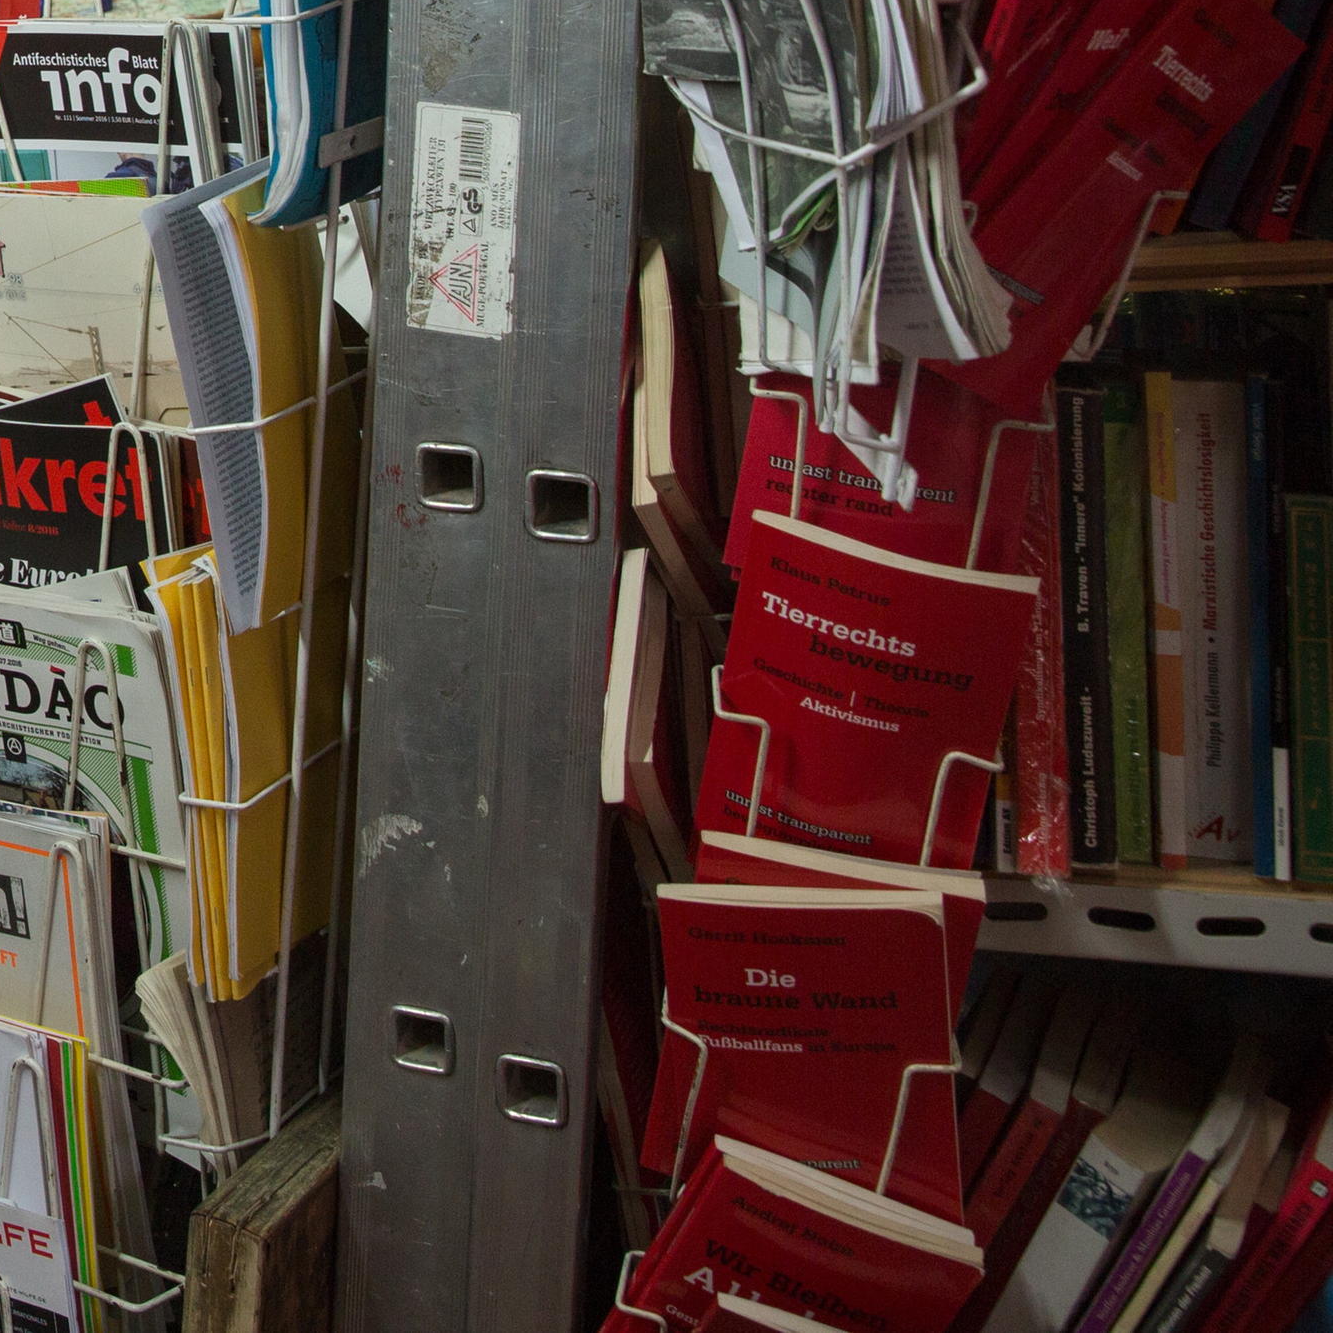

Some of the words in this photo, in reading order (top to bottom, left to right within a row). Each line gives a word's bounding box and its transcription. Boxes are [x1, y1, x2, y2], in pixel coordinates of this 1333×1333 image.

[13, 52, 107, 69] Antifaschistisches
[132, 55, 159, 70] Blatt
[1069, 395, 1086, 492] Kolonisierung
[1196, 411, 1218, 541] Geschichtslosigkeit
[1076, 565, 1090, 614] Traven
[1201, 544, 1218, 631] Marxistische
[761, 589, 917, 658] Tierrechts
[808, 633, 975, 692] bewegung
[1203, 651, 1222, 718] Kellermann
[800, 695, 900, 733] Aktivismus
[1205, 721, 1224, 768] Philippe
[777, 809, 872, 846] transparent
[1082, 779, 1099, 848] Christoph
[693, 985, 801, 1010] braune
[811, 991, 899, 1010] Wand
[745, 968, 797, 988] Die
[699, 1035, 803, 1053] Fußballfans
